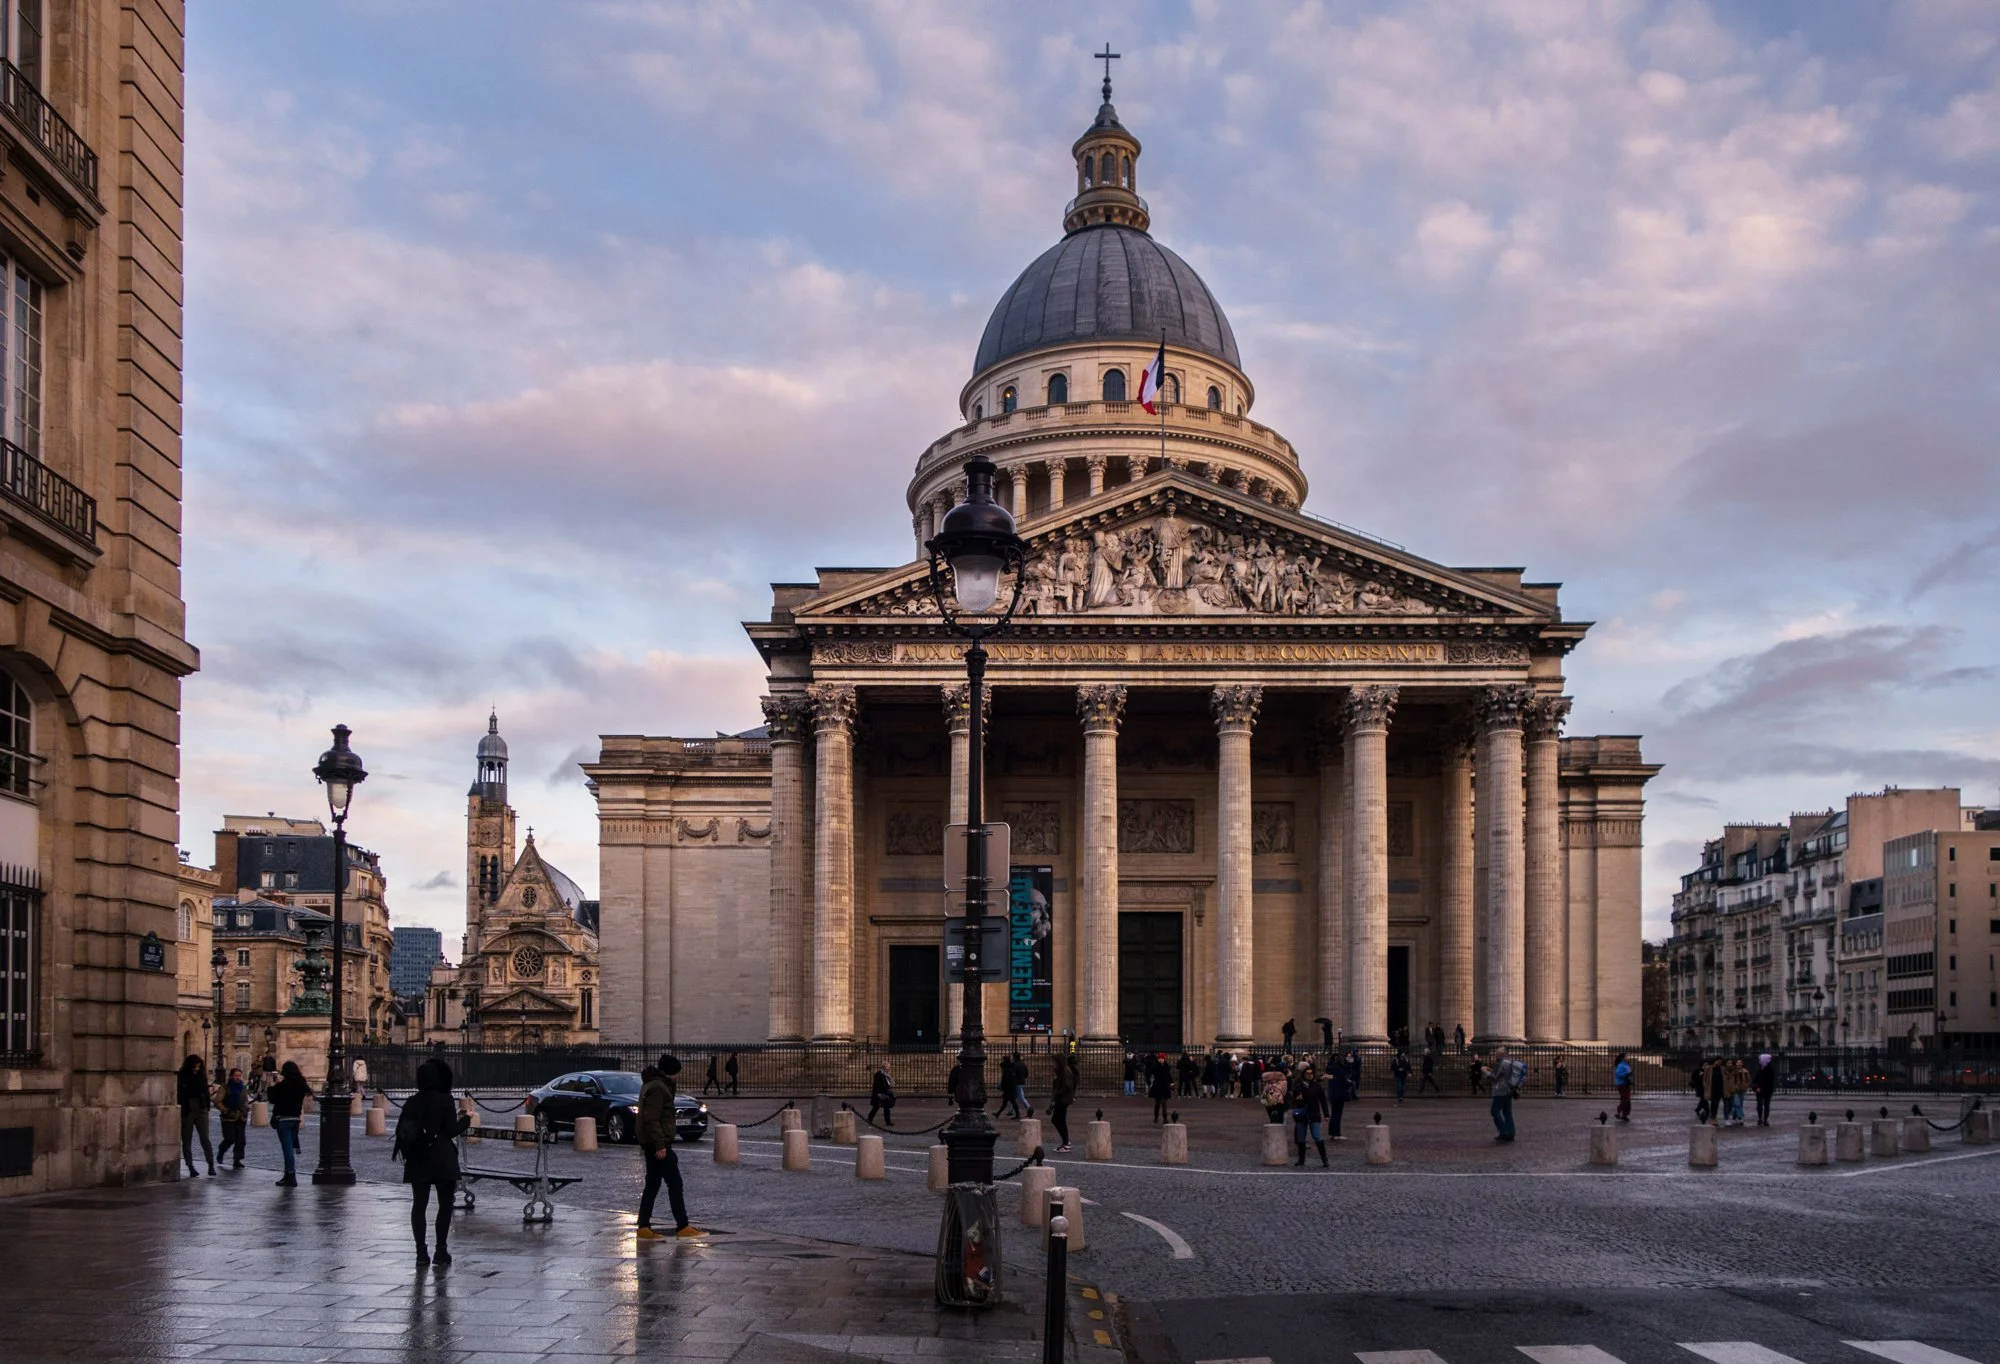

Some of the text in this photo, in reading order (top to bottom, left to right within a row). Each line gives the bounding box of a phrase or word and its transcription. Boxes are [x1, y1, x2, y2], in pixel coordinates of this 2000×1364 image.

[901, 645, 1437, 660] AUX GANDS HOMMES LA PATRIE RECONNAISSANTE
